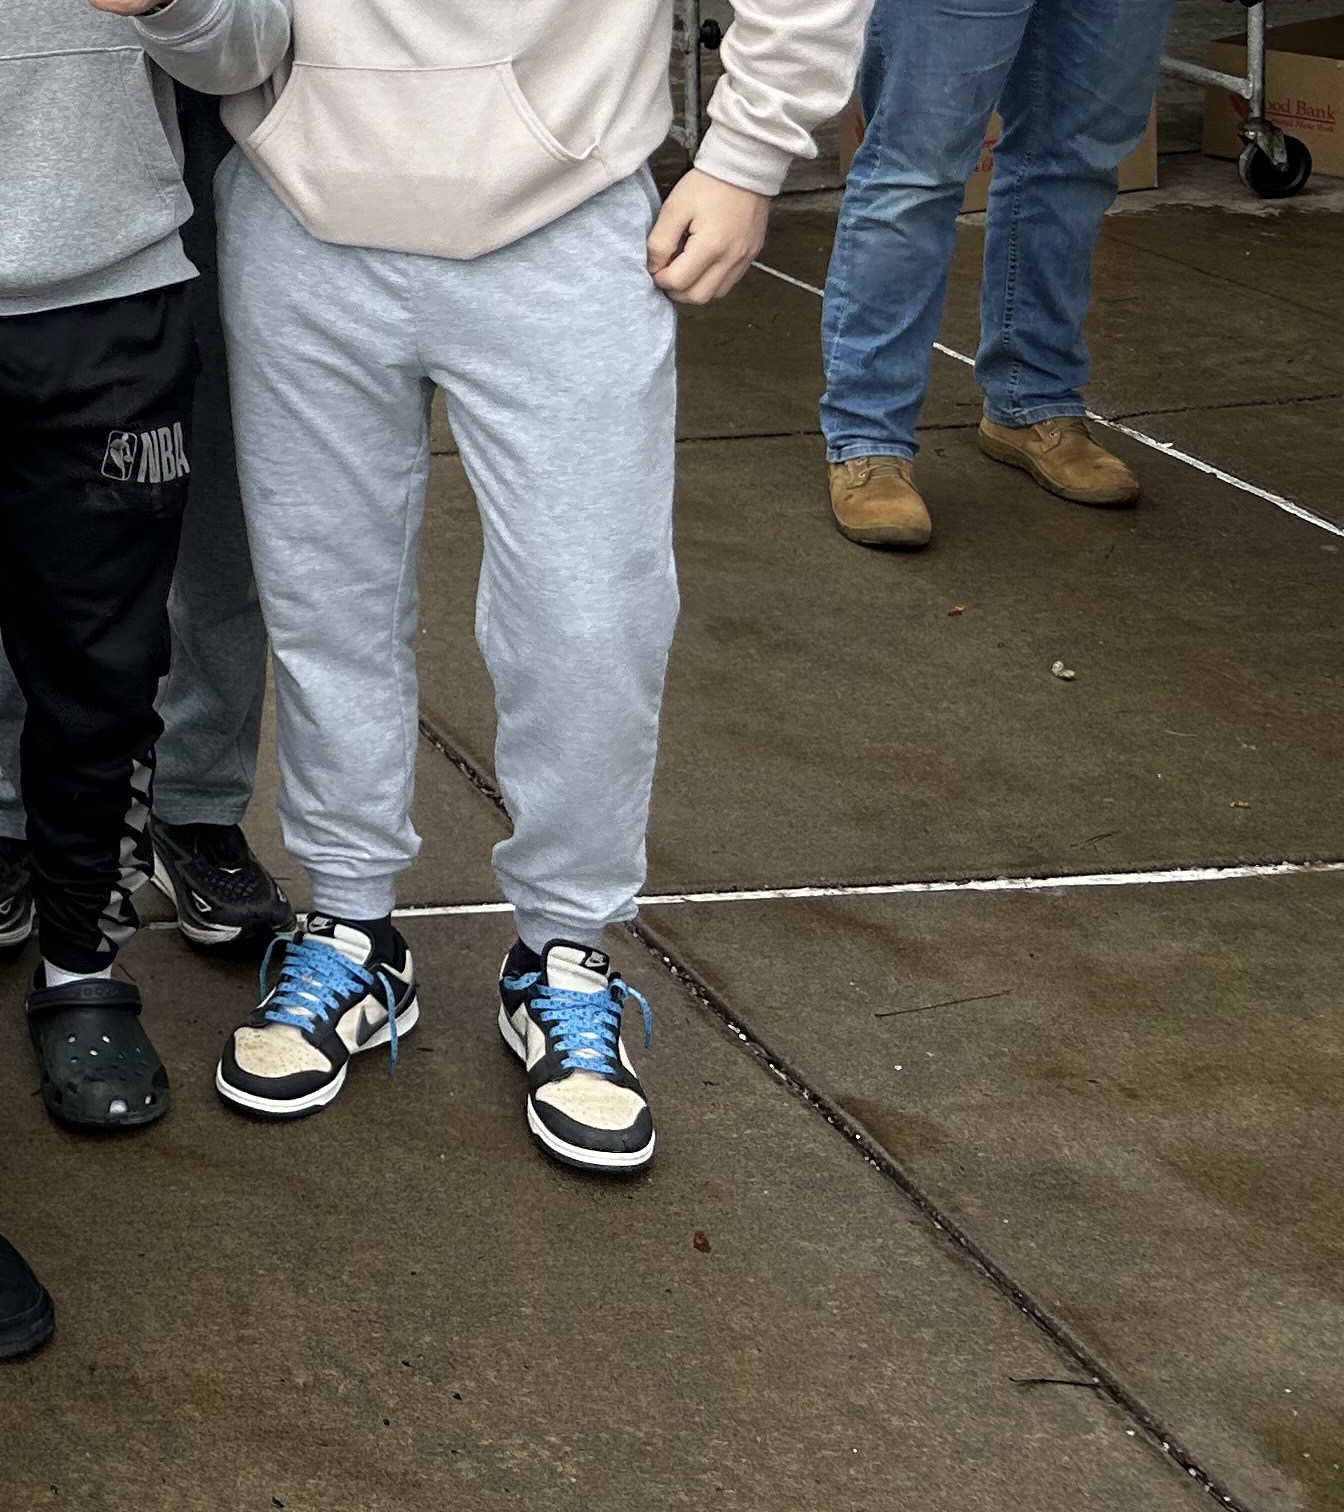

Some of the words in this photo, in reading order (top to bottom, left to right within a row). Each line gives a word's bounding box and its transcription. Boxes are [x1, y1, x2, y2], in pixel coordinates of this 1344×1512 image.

[1264, 98, 1291, 114] ood
[1296, 99, 1336, 121] Bank
[136, 421, 191, 484] NBA
